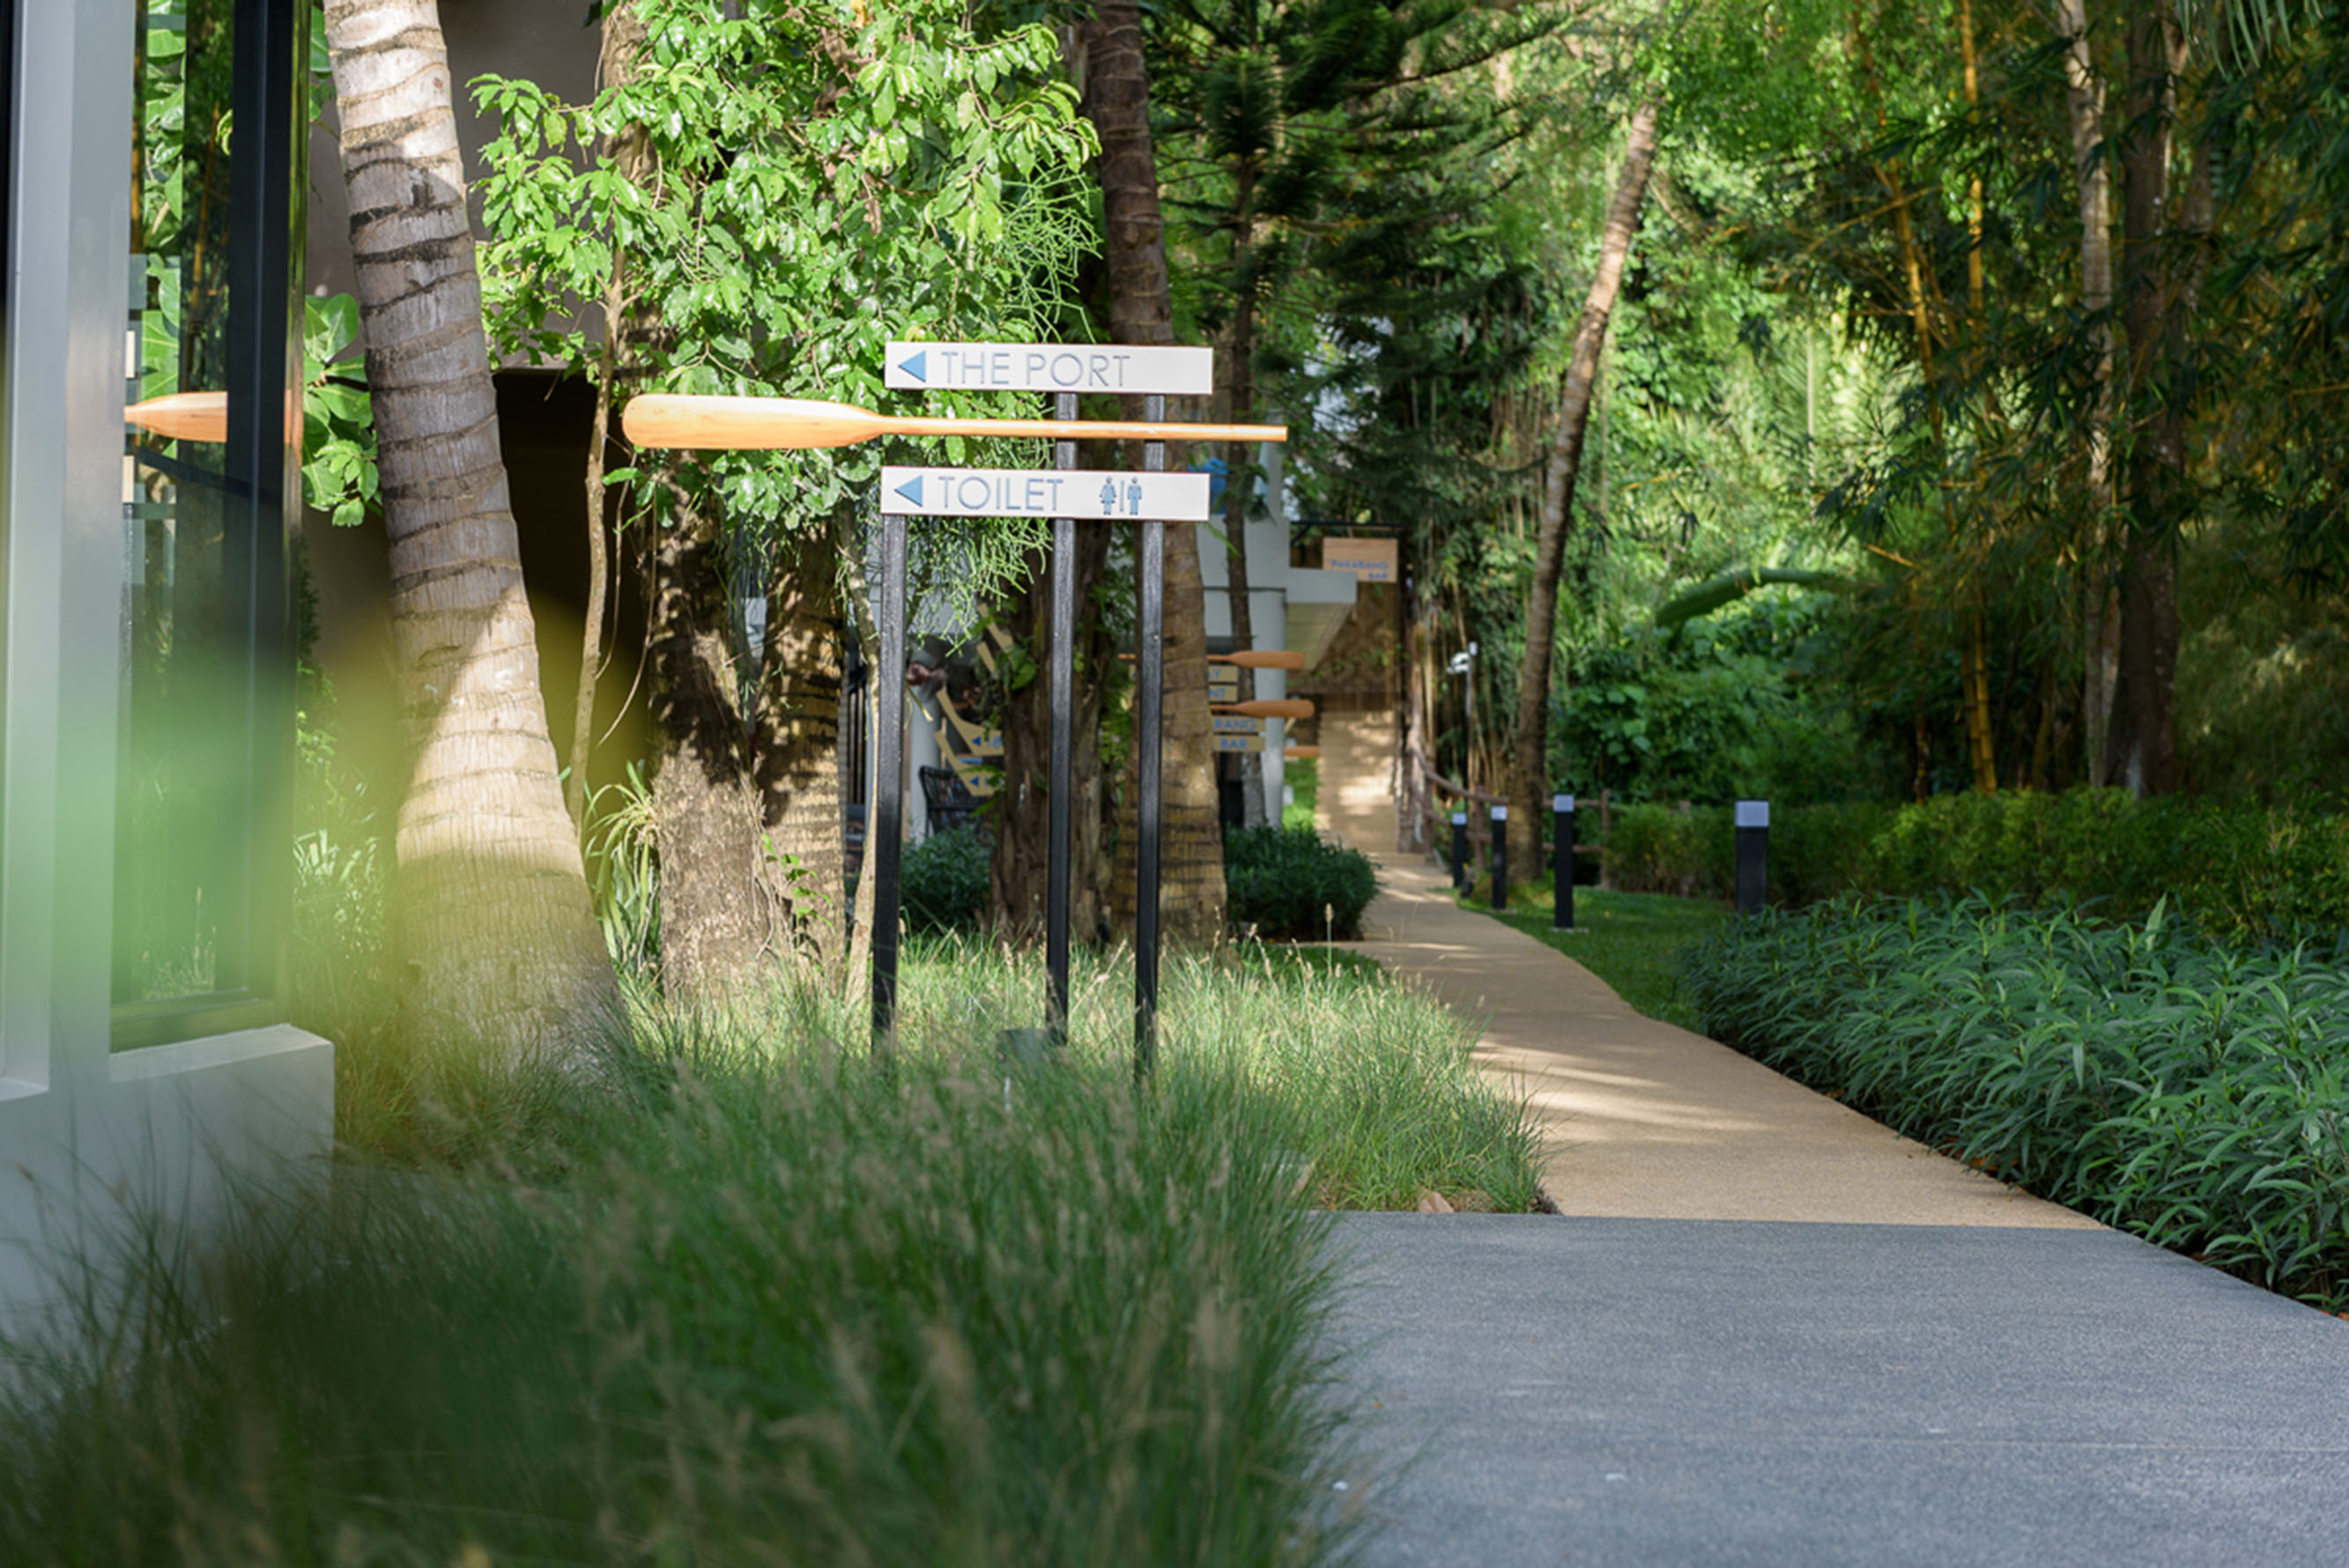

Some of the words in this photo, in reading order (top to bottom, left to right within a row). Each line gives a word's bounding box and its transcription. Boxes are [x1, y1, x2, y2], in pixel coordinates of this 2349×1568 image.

[941, 352, 1010, 384] THE
[1026, 353, 1130, 387] PORT
[937, 476, 1064, 512] TOILET
[1212, 717, 1257, 732] RANG
[1219, 736, 1249, 751] BAR
